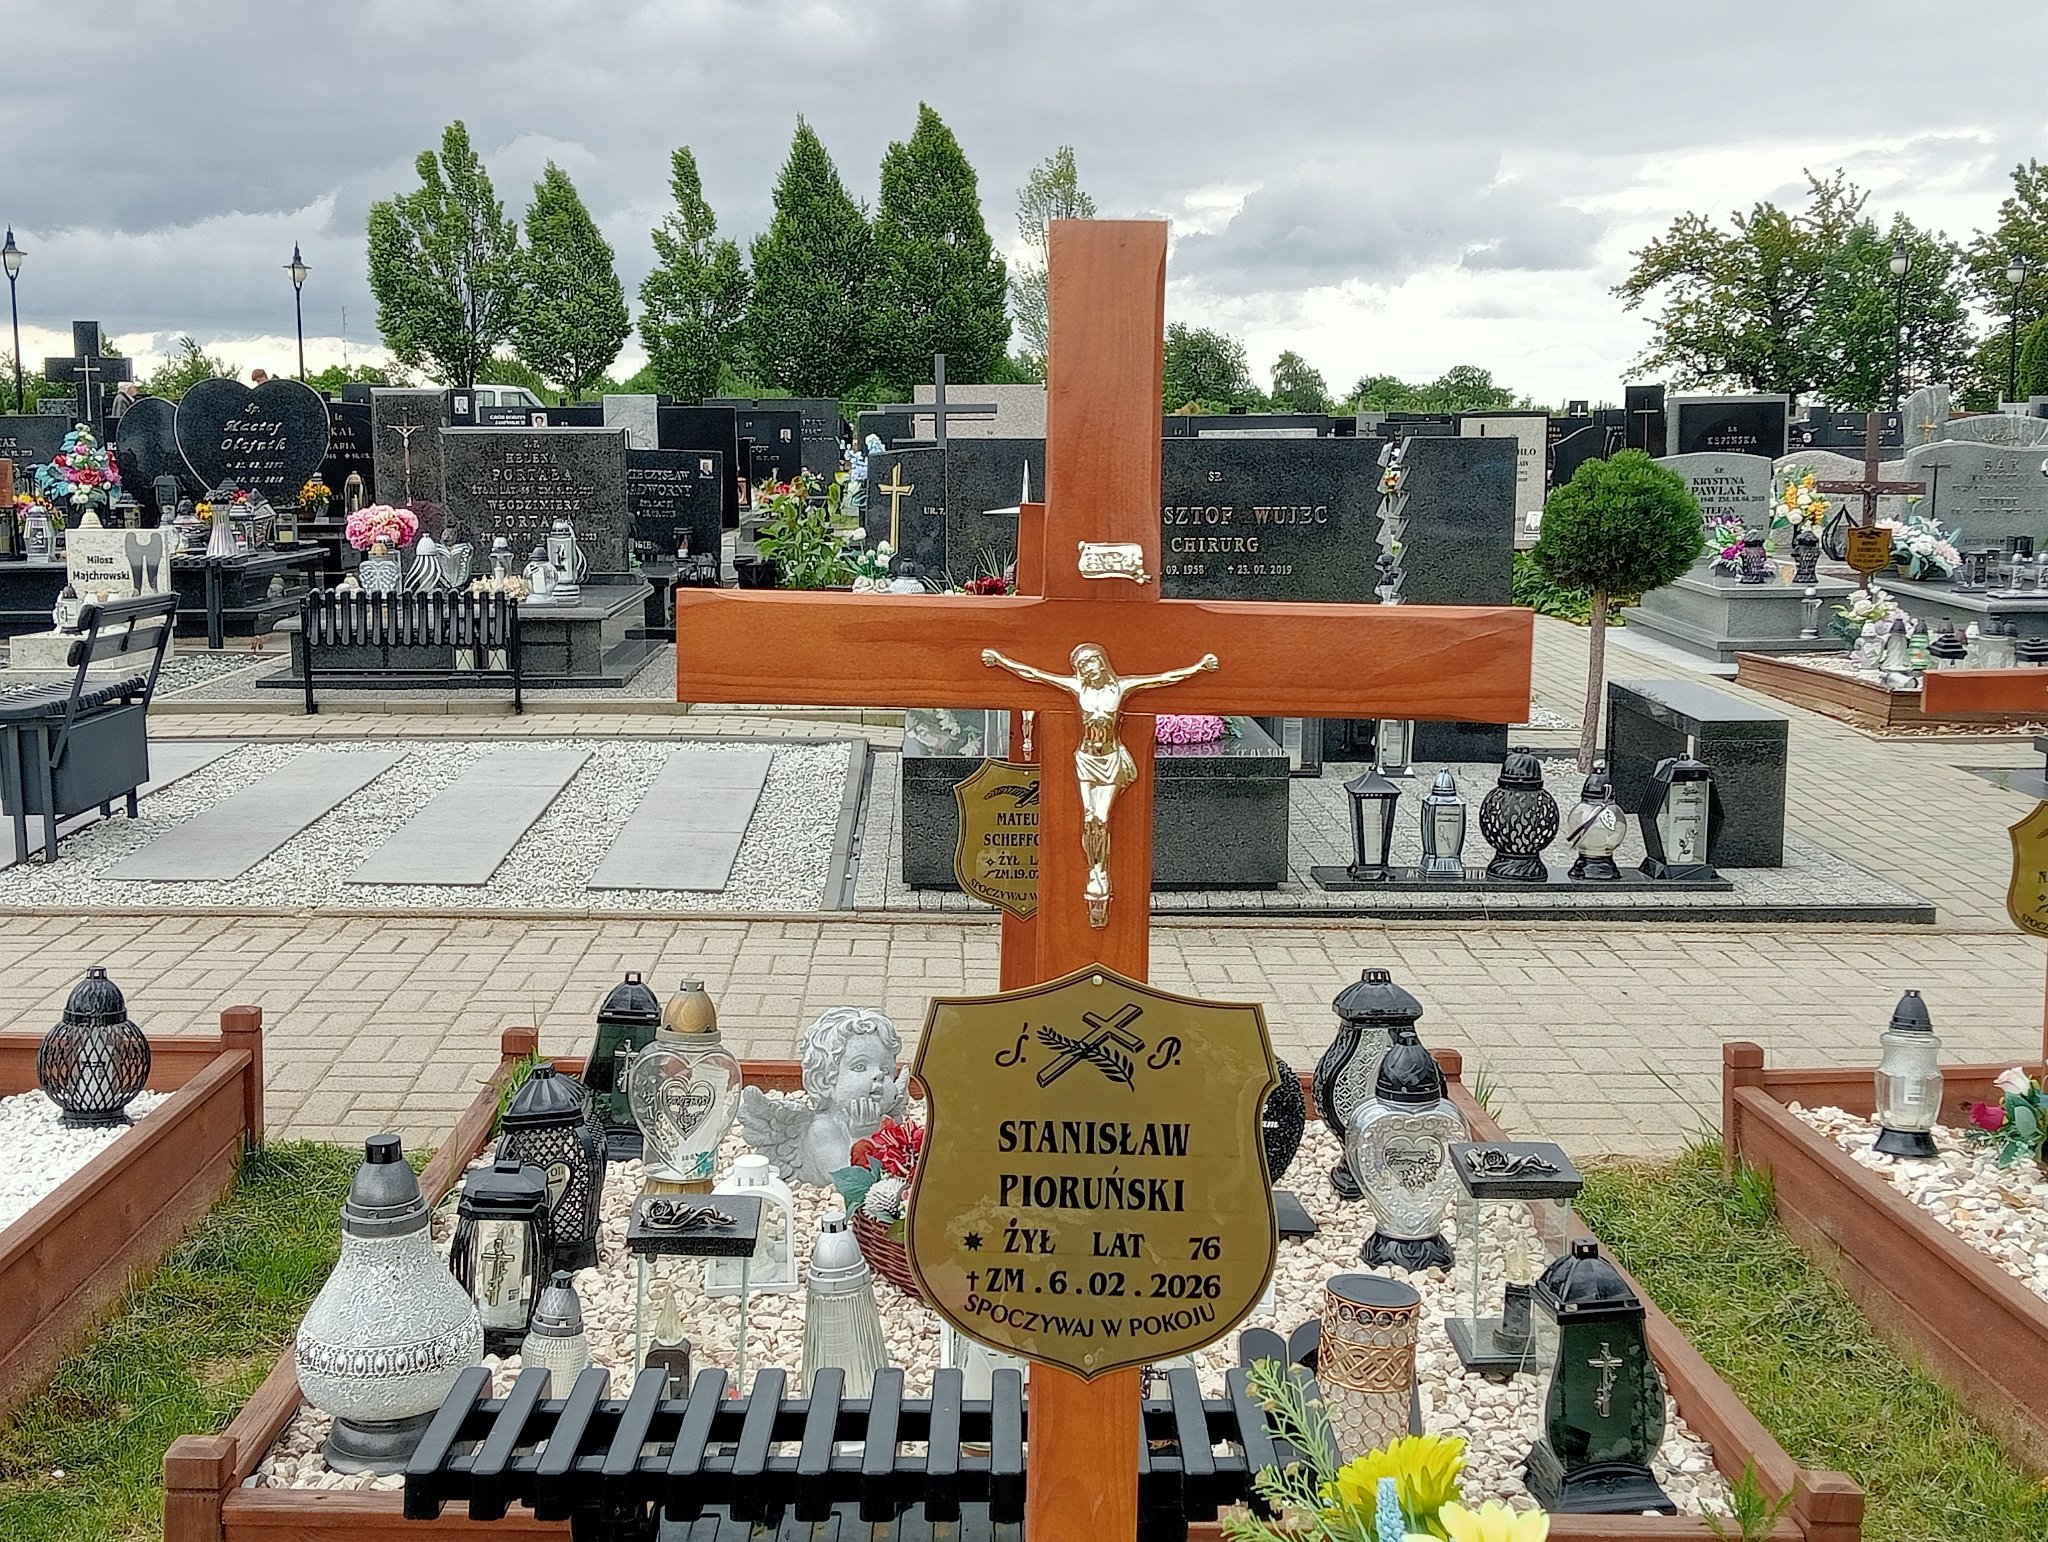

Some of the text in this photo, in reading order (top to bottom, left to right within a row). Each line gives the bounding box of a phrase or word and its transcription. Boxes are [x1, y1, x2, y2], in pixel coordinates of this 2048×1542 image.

[220, 437, 287, 454] Olejnik
[329, 442, 356, 450] ARIA
[626, 482, 693, 497] ADWORNY
[1692, 476, 1745, 486] KRYSTYNA
[1690, 485, 1747, 496] PAWLAK
[1161, 505, 1329, 525] SZTOF WUJEC
[1170, 537, 1260, 553] CHIRURG
[72, 570, 131, 583] Majchrowski
[967, 877, 1028, 901] SPOCZYWAJ
[999, 1119, 1191, 1157] STANISŁAW
[999, 1165, 1185, 1212] PIORUŃSKI
[1003, 1217, 1221, 1261] ŻYŁ LAT 76
[963, 1293, 1217, 1338] SPOCZYWAJ W POKOJU
